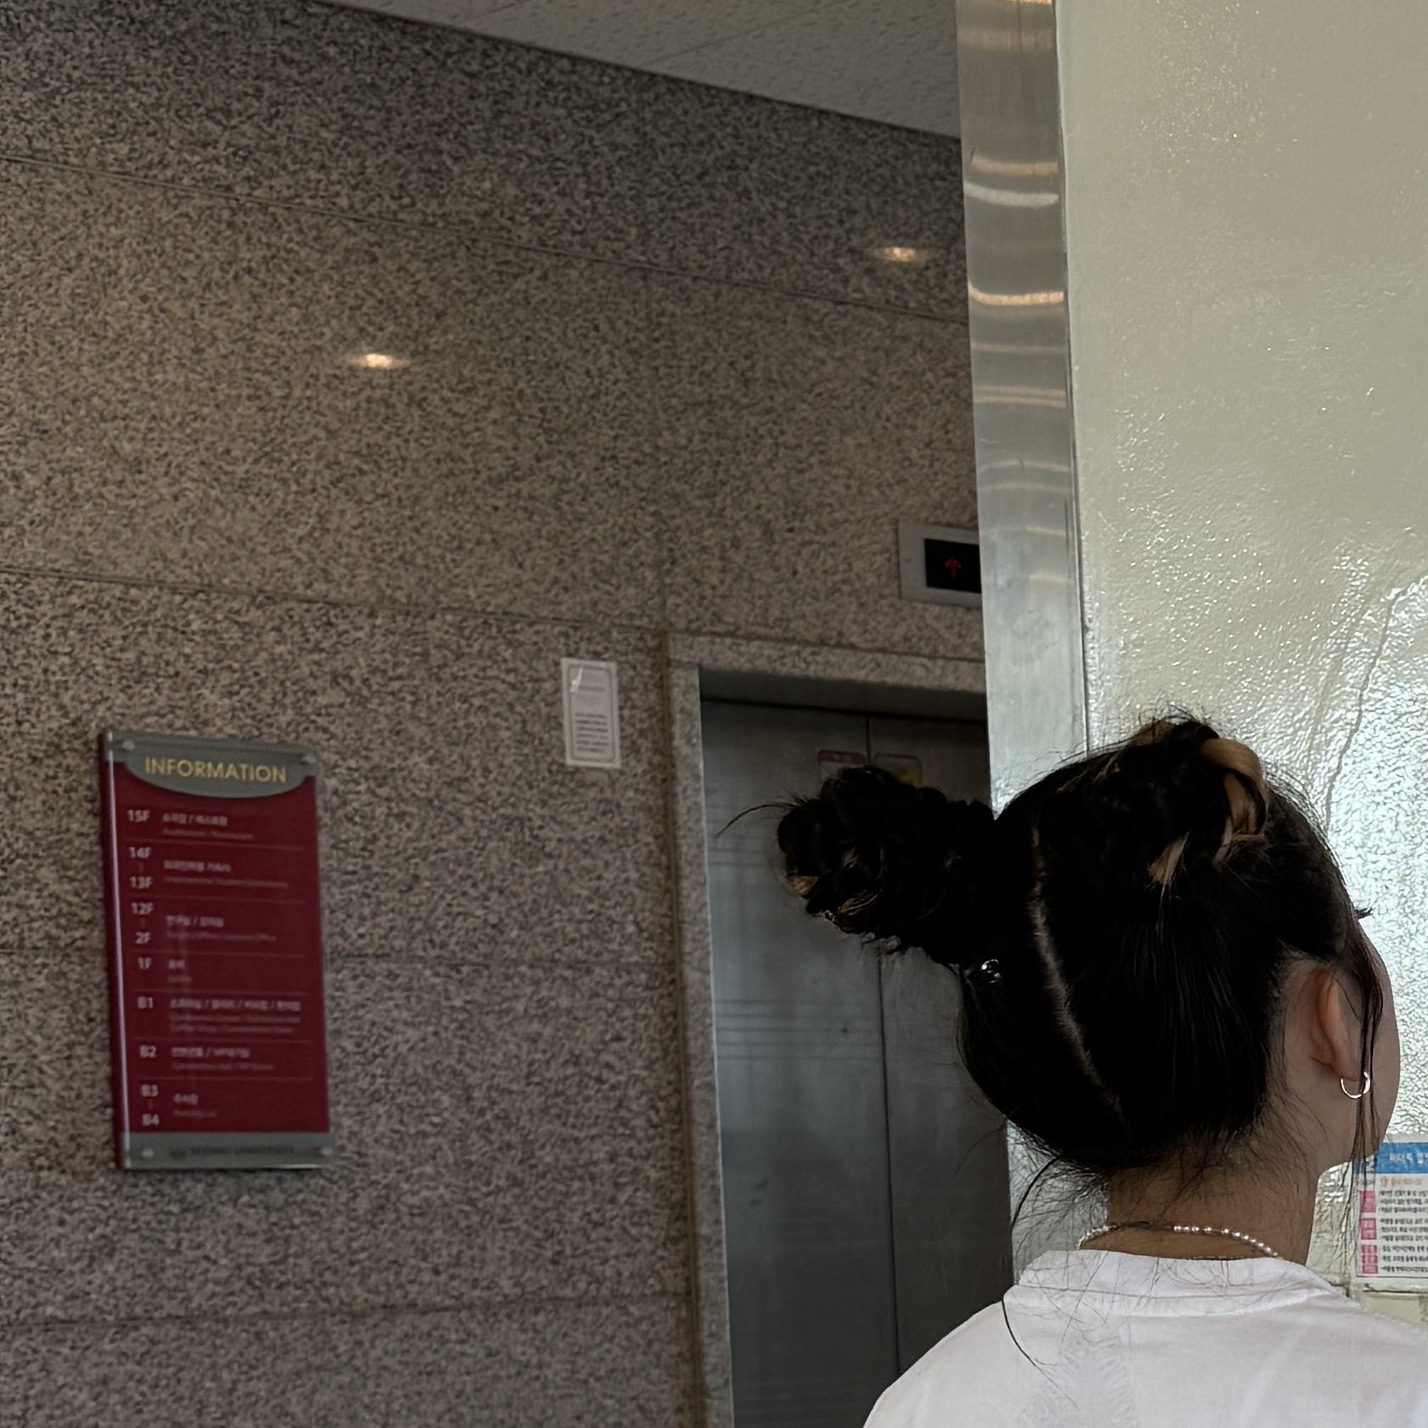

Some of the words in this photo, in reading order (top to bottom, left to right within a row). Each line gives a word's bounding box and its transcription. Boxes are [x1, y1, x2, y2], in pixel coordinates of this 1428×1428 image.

[145, 758, 286, 783] INFORMATION
[127, 810, 151, 823] 15F
[131, 903, 154, 915] 12F
[135, 932, 151, 944] 2F
[137, 958, 152, 970] 1F
[140, 1046, 156, 1058] B2
